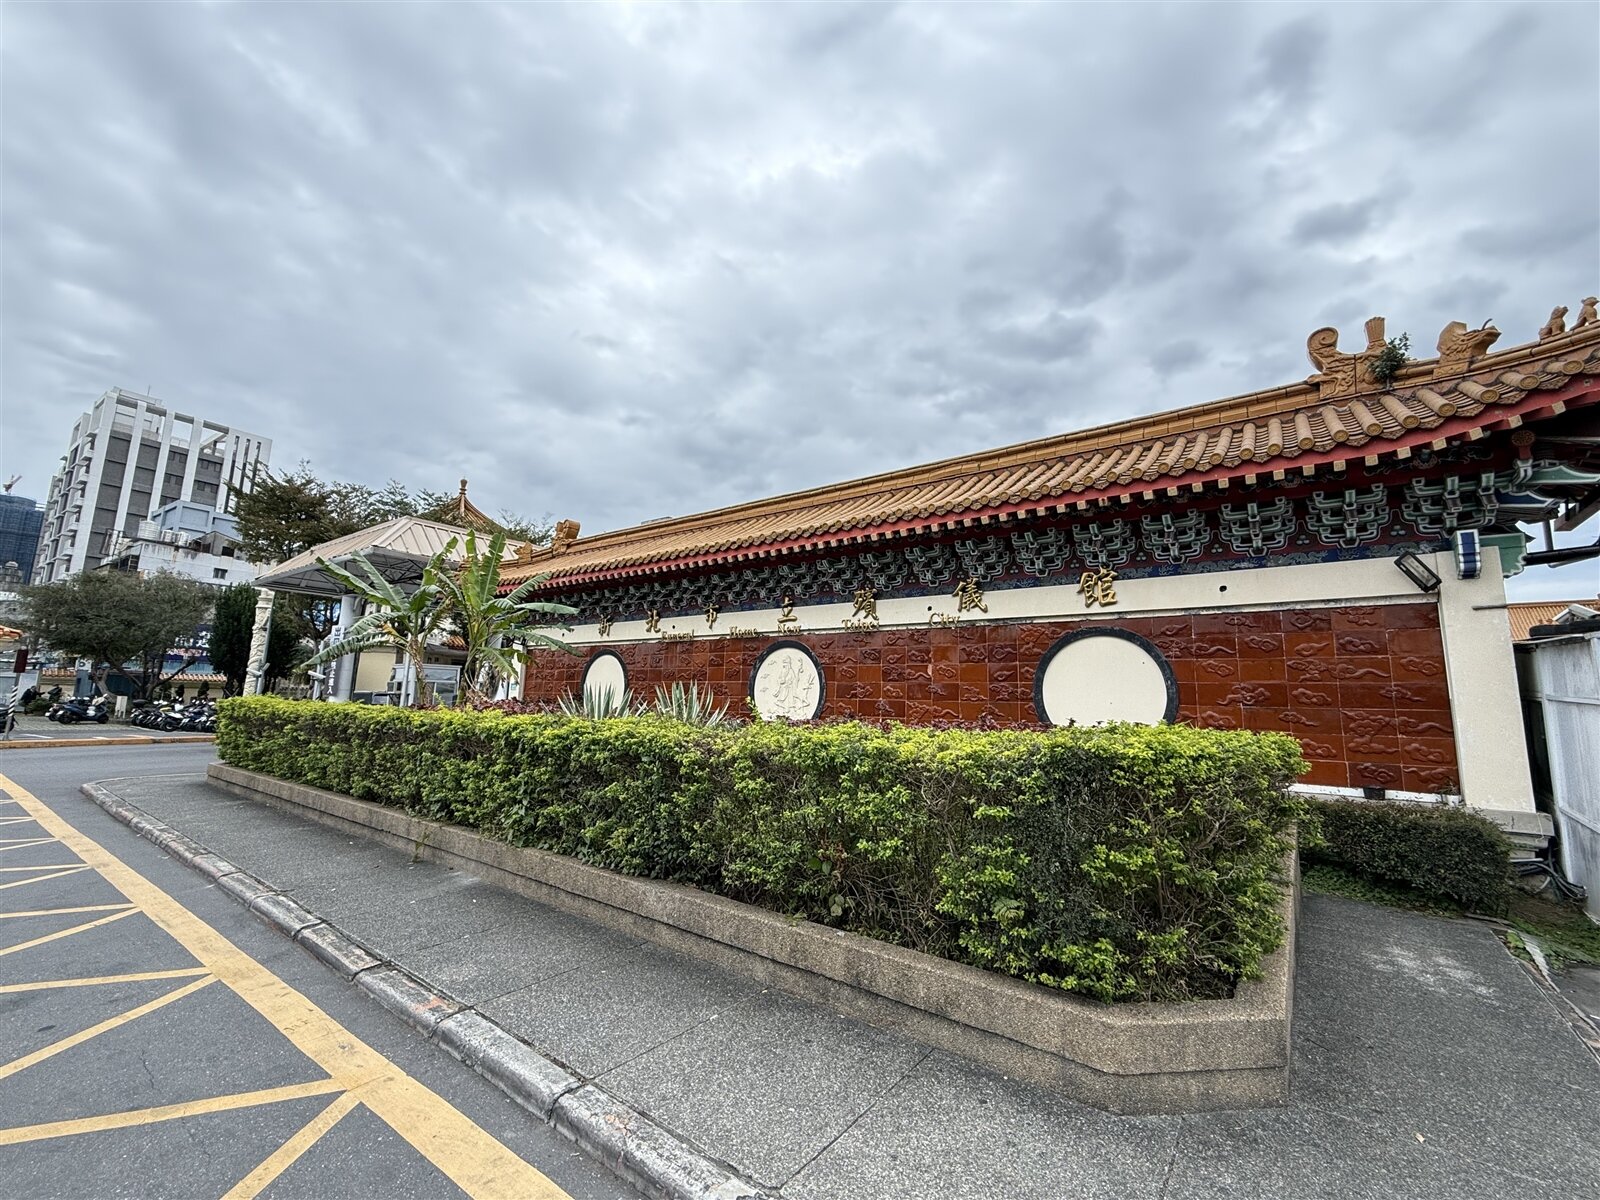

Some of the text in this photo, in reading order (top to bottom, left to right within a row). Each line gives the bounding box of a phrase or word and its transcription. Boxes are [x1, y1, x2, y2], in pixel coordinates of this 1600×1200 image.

[777, 623, 802, 635] New
[841, 618, 880, 634] Taipei
[928, 611, 961, 628] City
